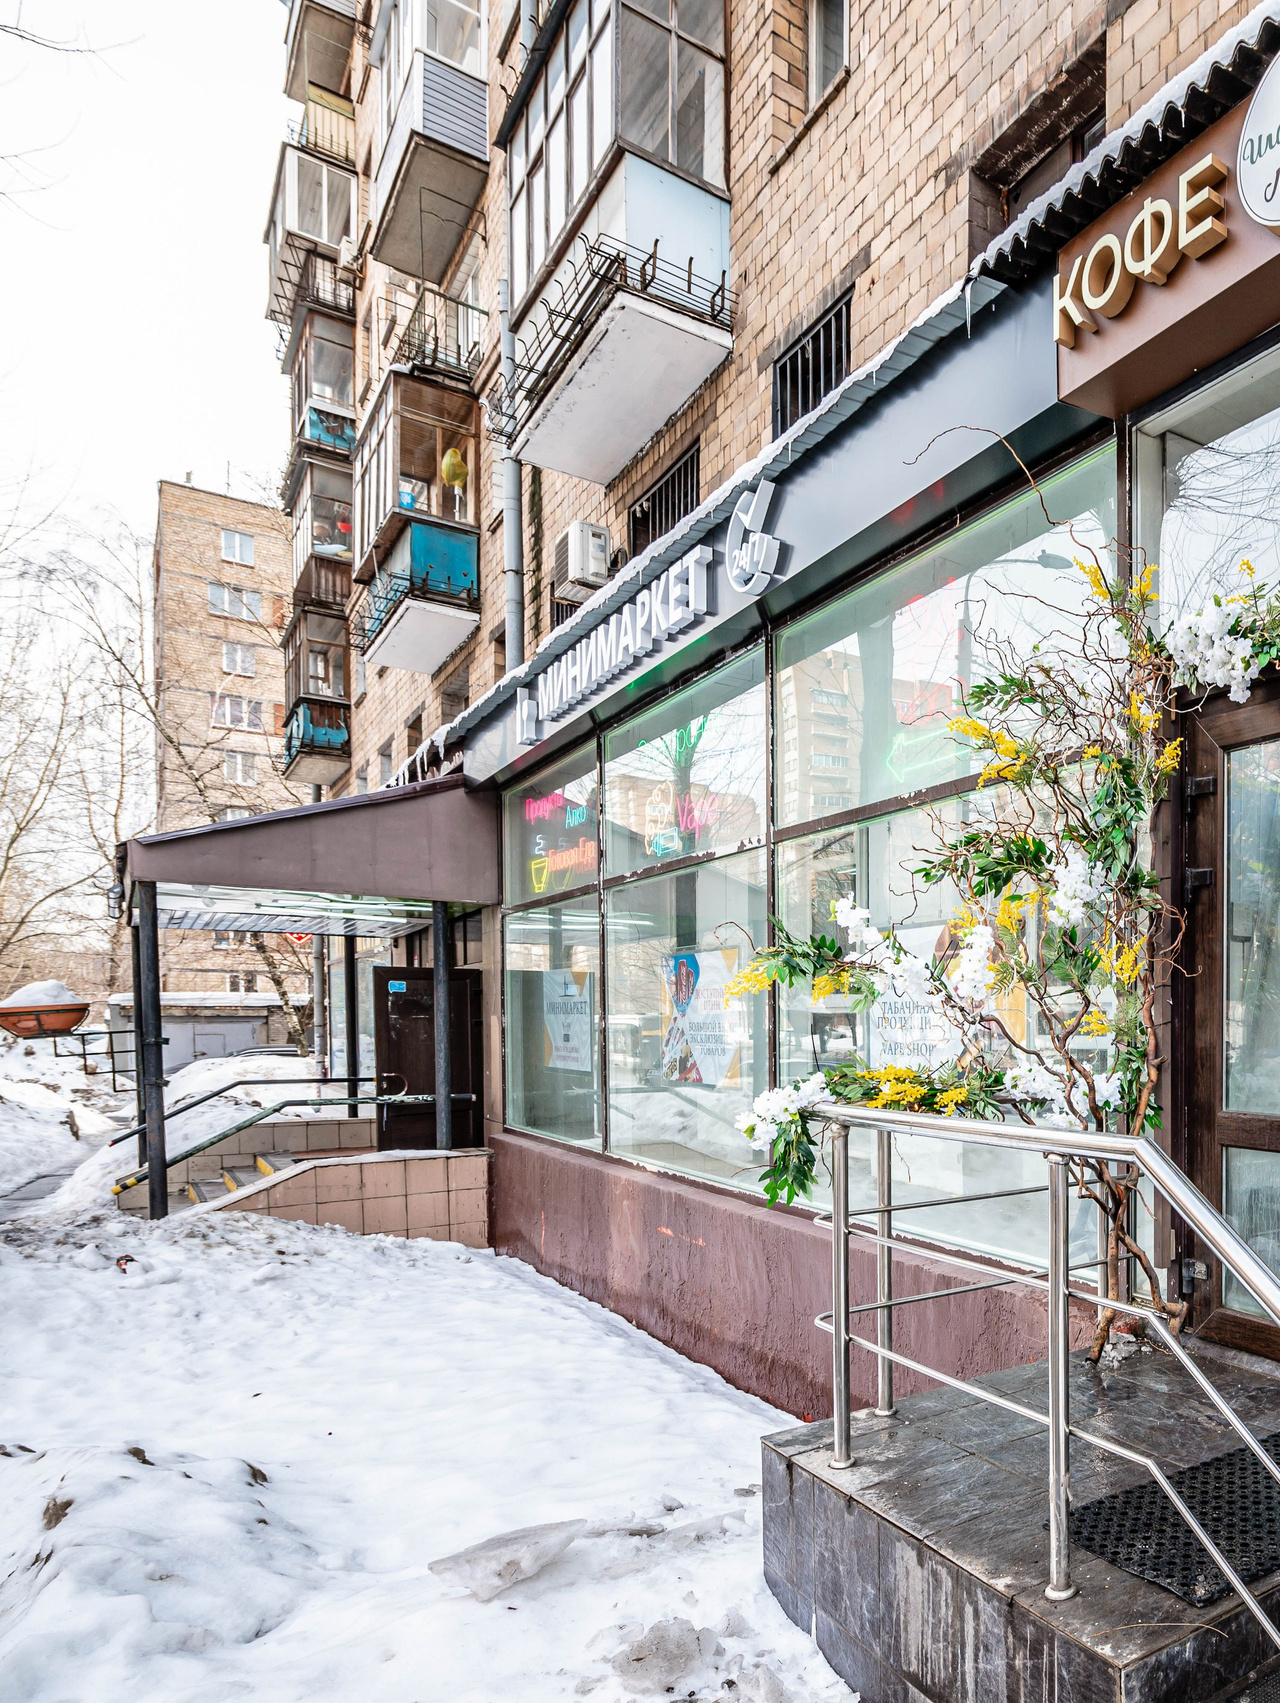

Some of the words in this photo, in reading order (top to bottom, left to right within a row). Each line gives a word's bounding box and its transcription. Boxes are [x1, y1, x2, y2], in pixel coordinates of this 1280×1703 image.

[1053, 153, 1226, 347] КОФЕ
[731, 531, 762, 578] 24/7
[538, 545, 713, 721] МИНИМАРКЕТ
[525, 792, 563, 825] Продукты
[565, 805, 587, 829] Алко
[676, 793, 720, 840] Vape
[694, 989, 727, 999] ДОСТУПН
[717, 1021, 740, 1033] ВЫОР
[877, 1016, 933, 1032] ПРОДУКЦИ
[882, 1040, 905, 1056] VAPE
[906, 1041, 935, 1057] SHOP
